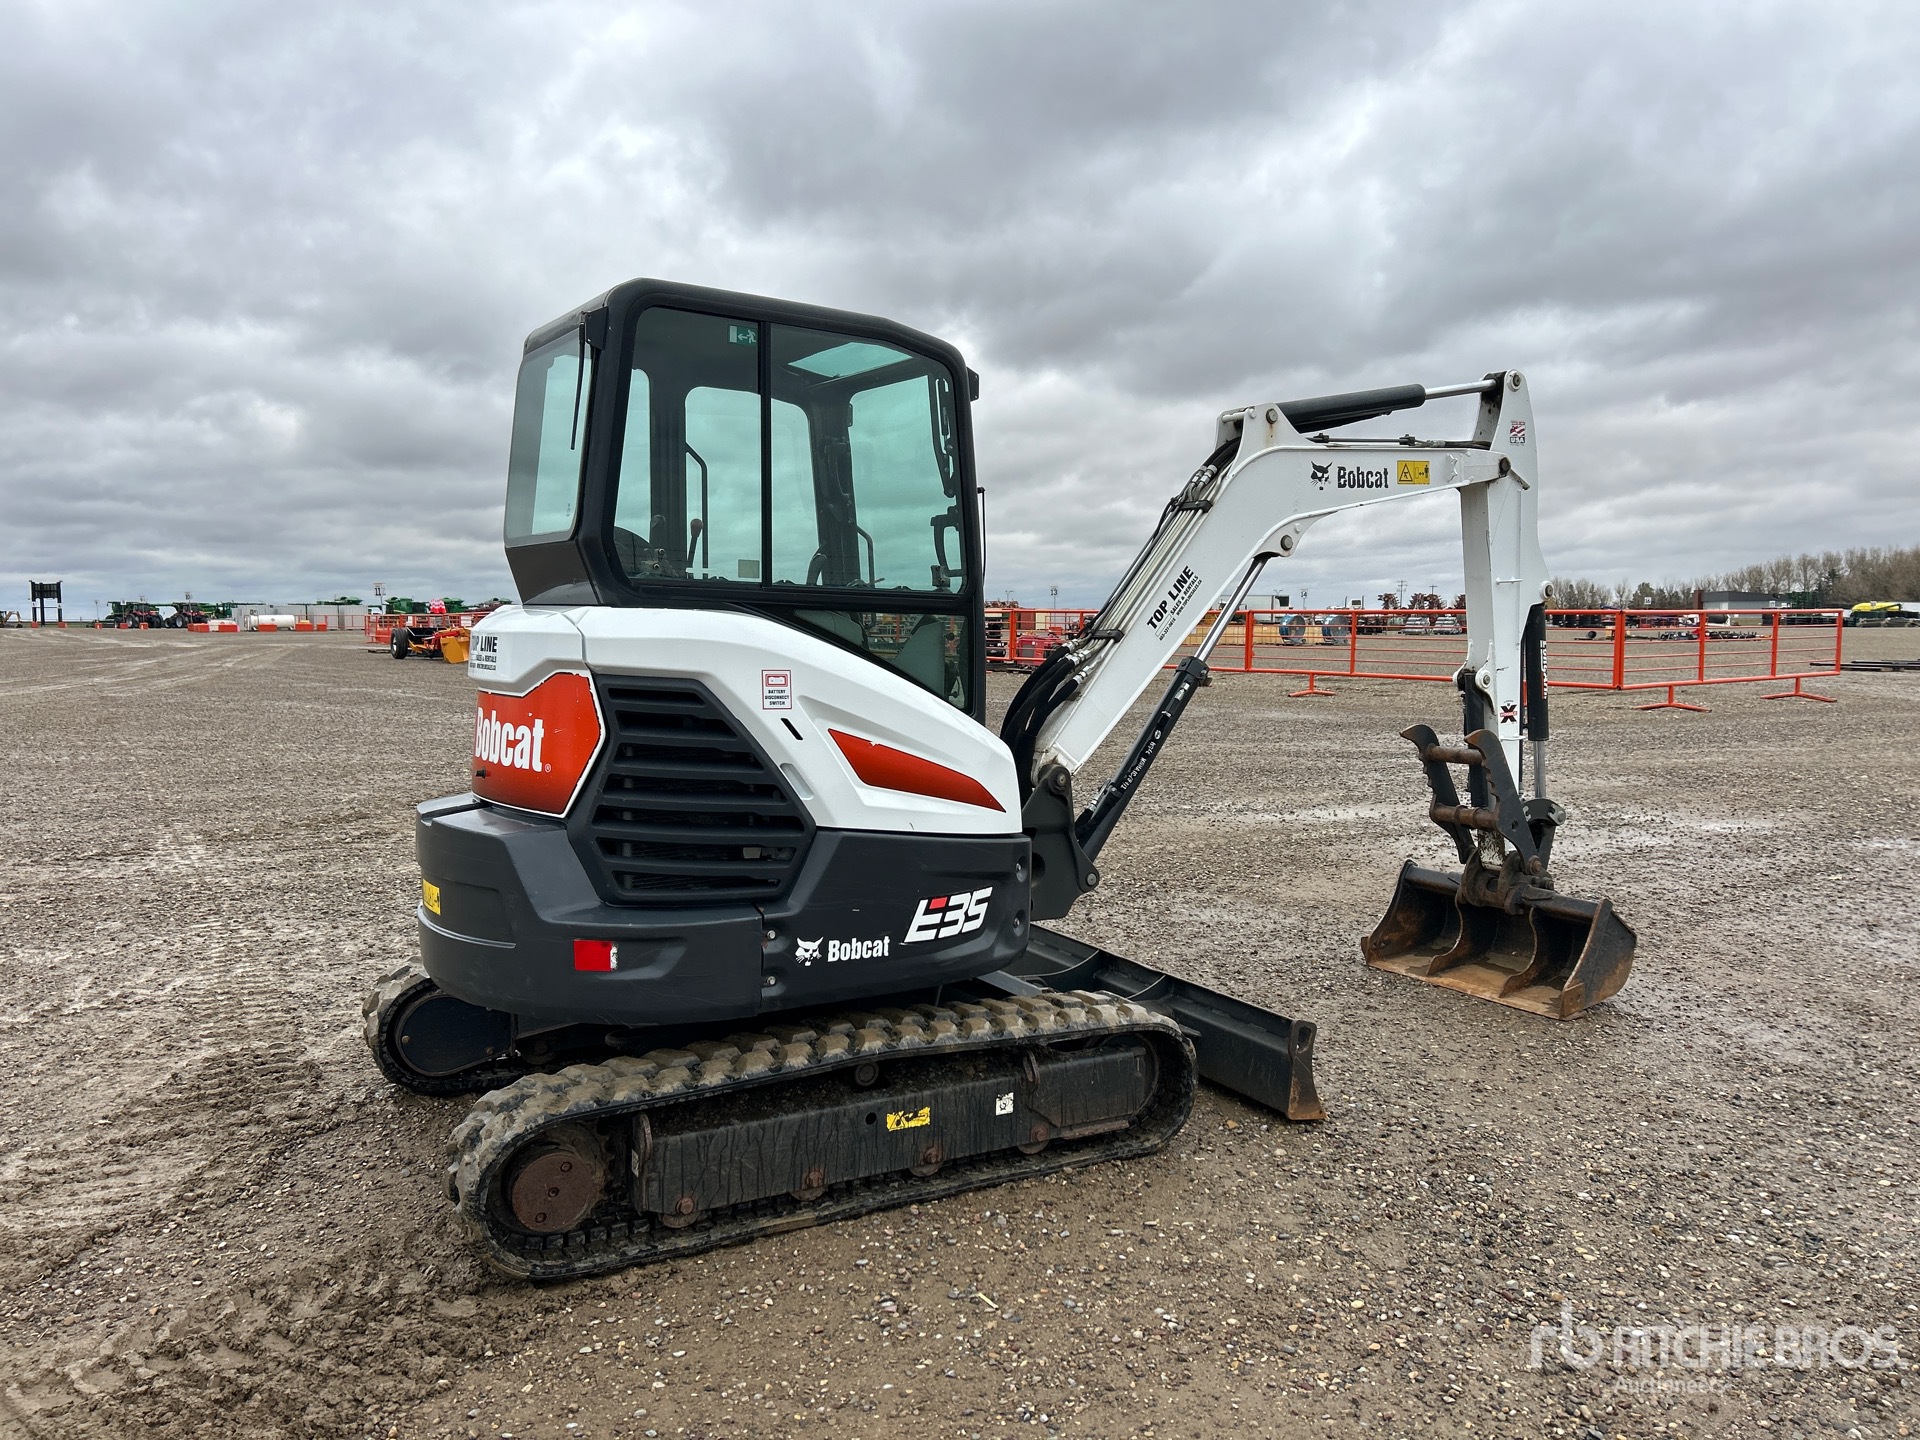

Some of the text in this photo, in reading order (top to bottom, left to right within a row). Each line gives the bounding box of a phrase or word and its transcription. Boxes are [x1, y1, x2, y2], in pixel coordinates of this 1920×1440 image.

[1337, 466, 1389, 489] Bobcat
[1147, 565, 1194, 629] TOP LINE
[1170, 599, 1182, 615] SALES
[1183, 575, 1199, 596] RENTALS
[480, 635, 498, 653] LINE
[475, 706, 545, 772] Bobcat
[904, 886, 993, 943] E35
[827, 935, 891, 962] Bobcat
